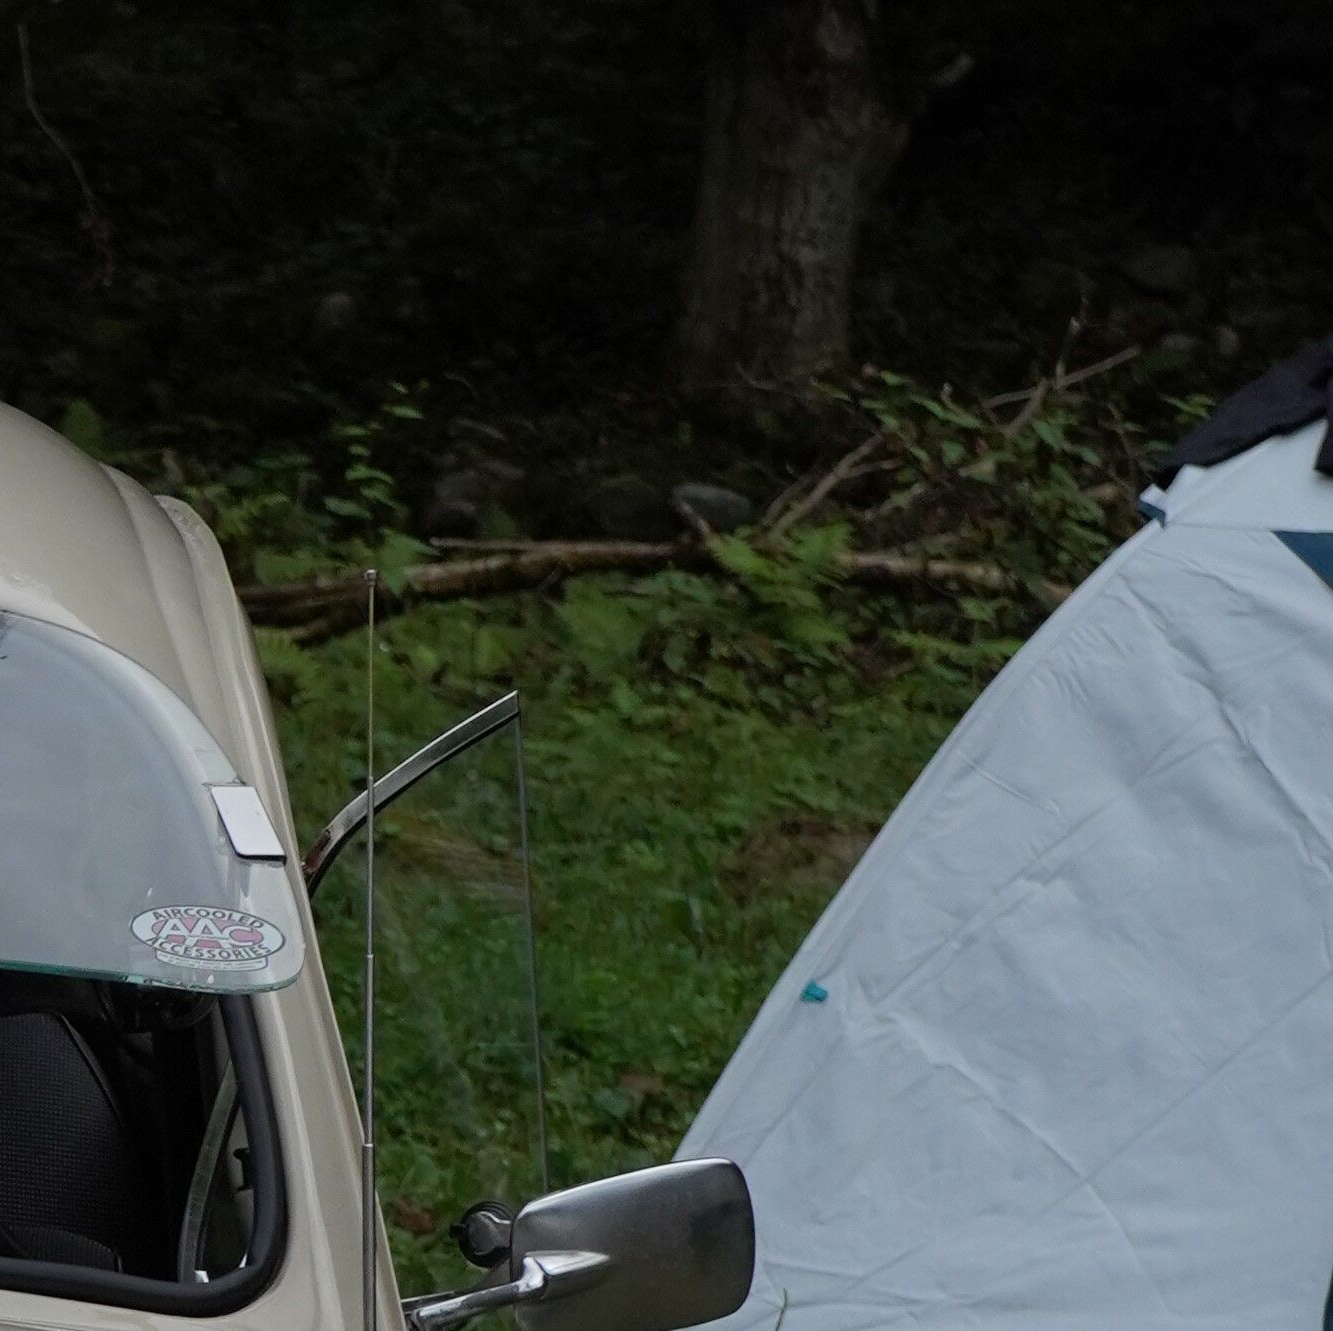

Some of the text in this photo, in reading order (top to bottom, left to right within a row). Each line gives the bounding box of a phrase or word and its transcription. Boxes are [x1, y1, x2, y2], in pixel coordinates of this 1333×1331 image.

[151, 907, 265, 930] AIRCOOLED
[156, 917, 256, 949] AAC
[144, 936, 272, 961] ACCESSORIES
